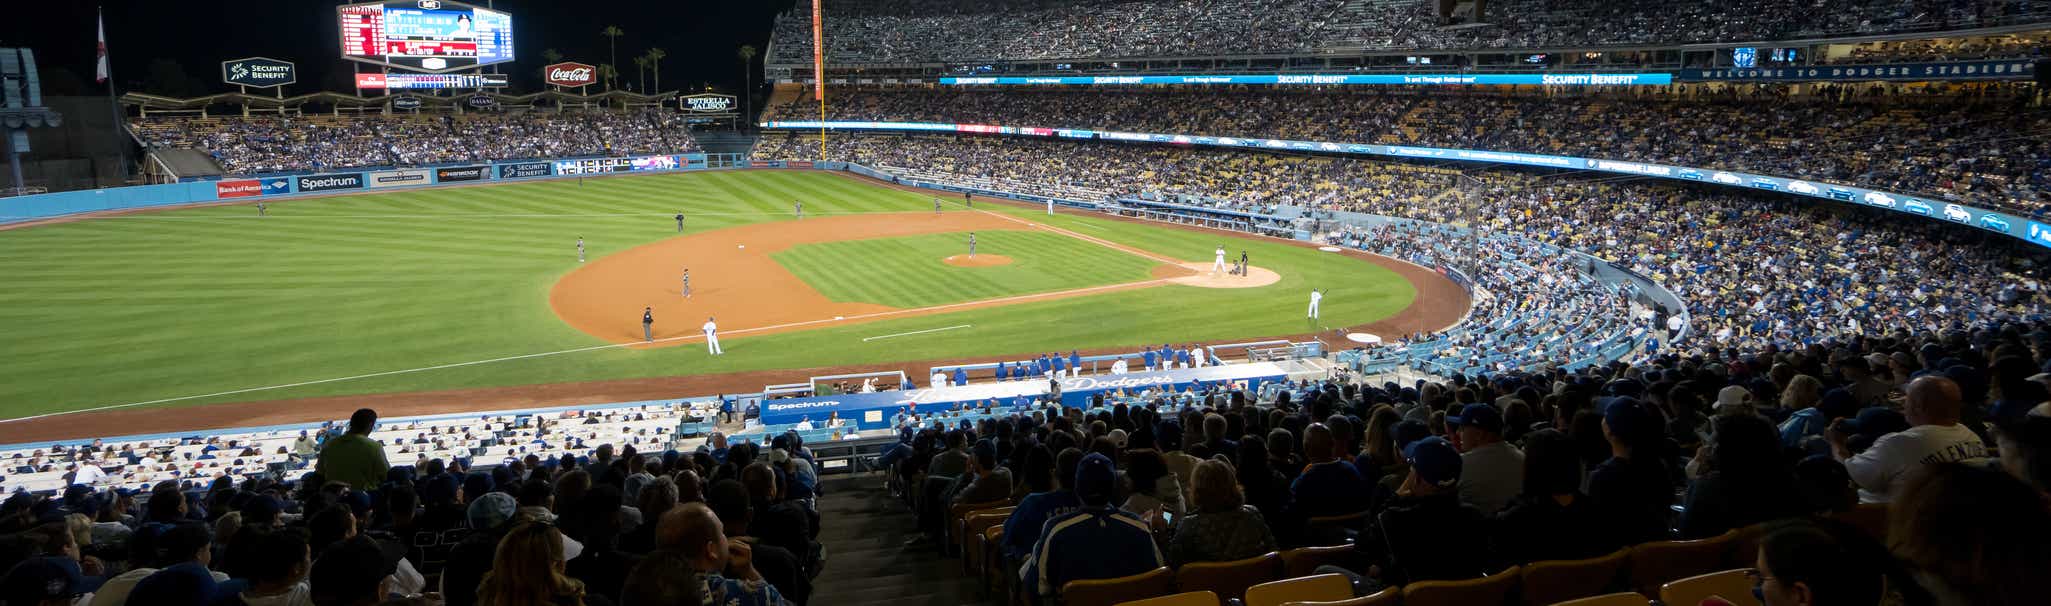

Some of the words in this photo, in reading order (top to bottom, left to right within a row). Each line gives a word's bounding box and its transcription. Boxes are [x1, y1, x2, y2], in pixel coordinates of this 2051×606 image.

[251, 64, 290, 72] SECURITY
[1702, 69, 1784, 78] WELCOME
[1797, 68, 1819, 77] TO
[1832, 67, 1910, 77] DODGER
[1925, 63, 2023, 75] STADIUM
[1278, 75, 1312, 84] SECURITY
[1542, 74, 1589, 85] SECURITY
[1590, 74, 1635, 84] BENEFIT
[301, 176, 356, 189] Spectrum
[219, 186, 236, 194] Bank
[1062, 375, 1173, 391] Dodgers
[768, 401, 836, 412] Spectrum
